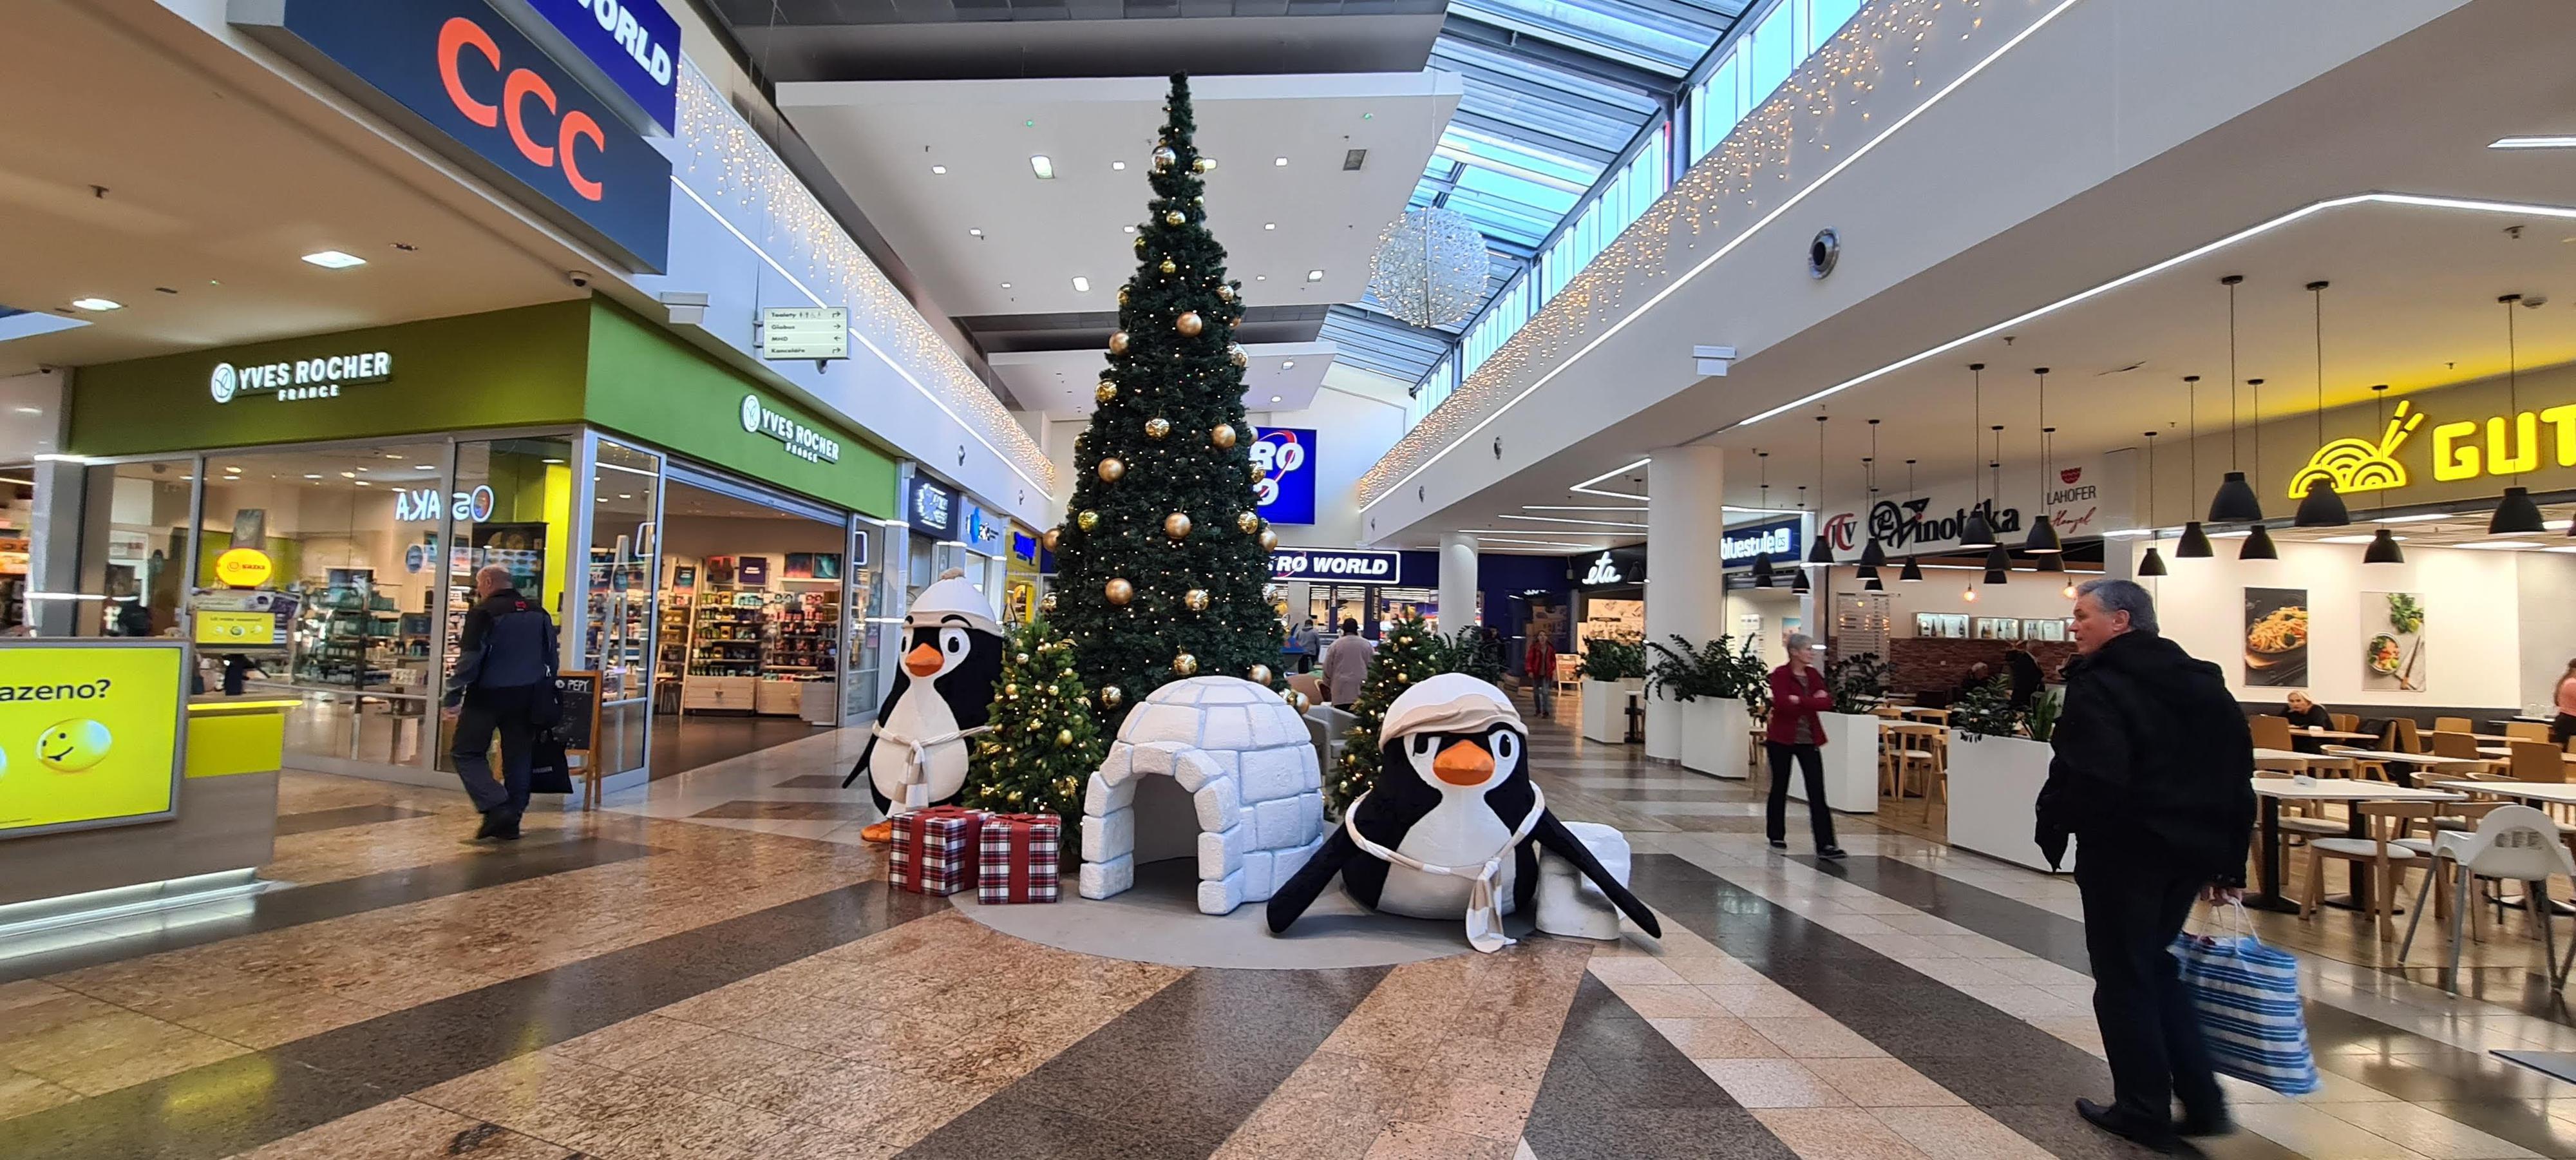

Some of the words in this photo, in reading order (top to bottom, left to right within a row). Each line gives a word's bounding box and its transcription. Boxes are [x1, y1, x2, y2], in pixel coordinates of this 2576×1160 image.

[438, 17, 605, 202] CCC
[239, 363, 290, 390] YVES
[295, 352, 392, 385] ROCHER
[278, 385, 340, 401] FRANCE
[762, 408, 794, 439] YVES
[796, 425, 839, 460] ROCHER
[2433, 404, 2576, 481] GUT
[786, 442, 818, 463] FRANCE
[2047, 486, 2096, 505] LAHOFER
[1869, 497, 2021, 549] Vinotka
[1313, 557, 1388, 575] WORLD
[1582, 551, 1622, 585] eta
